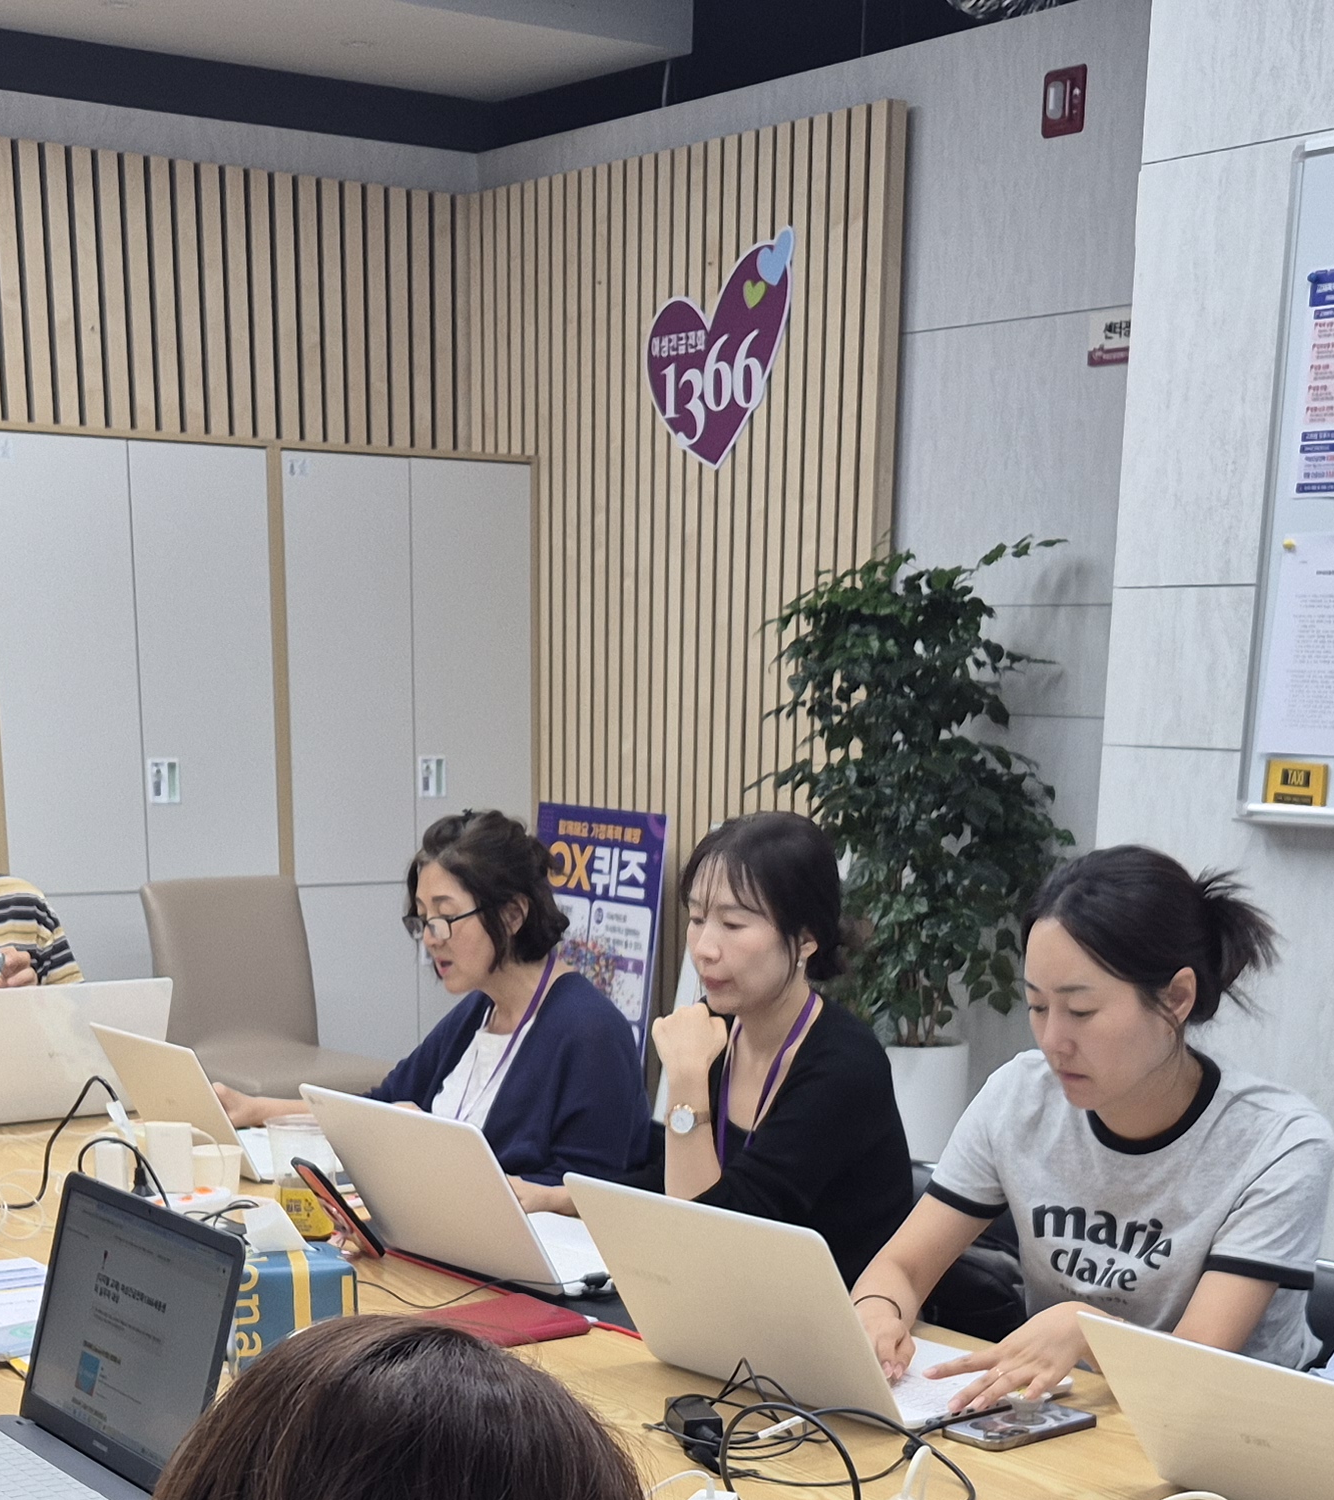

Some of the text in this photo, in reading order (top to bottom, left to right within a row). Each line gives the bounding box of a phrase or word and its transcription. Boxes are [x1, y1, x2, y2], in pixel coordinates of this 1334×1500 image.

[650, 329, 706, 358] 여성긴급전화
[660, 328, 763, 448] 1366
[1286, 769, 1306, 787] TAXI
[547, 841, 648, 900] OX퀴즈
[1032, 1204, 1172, 1270] marie
[1050, 1248, 1137, 1291] claire
